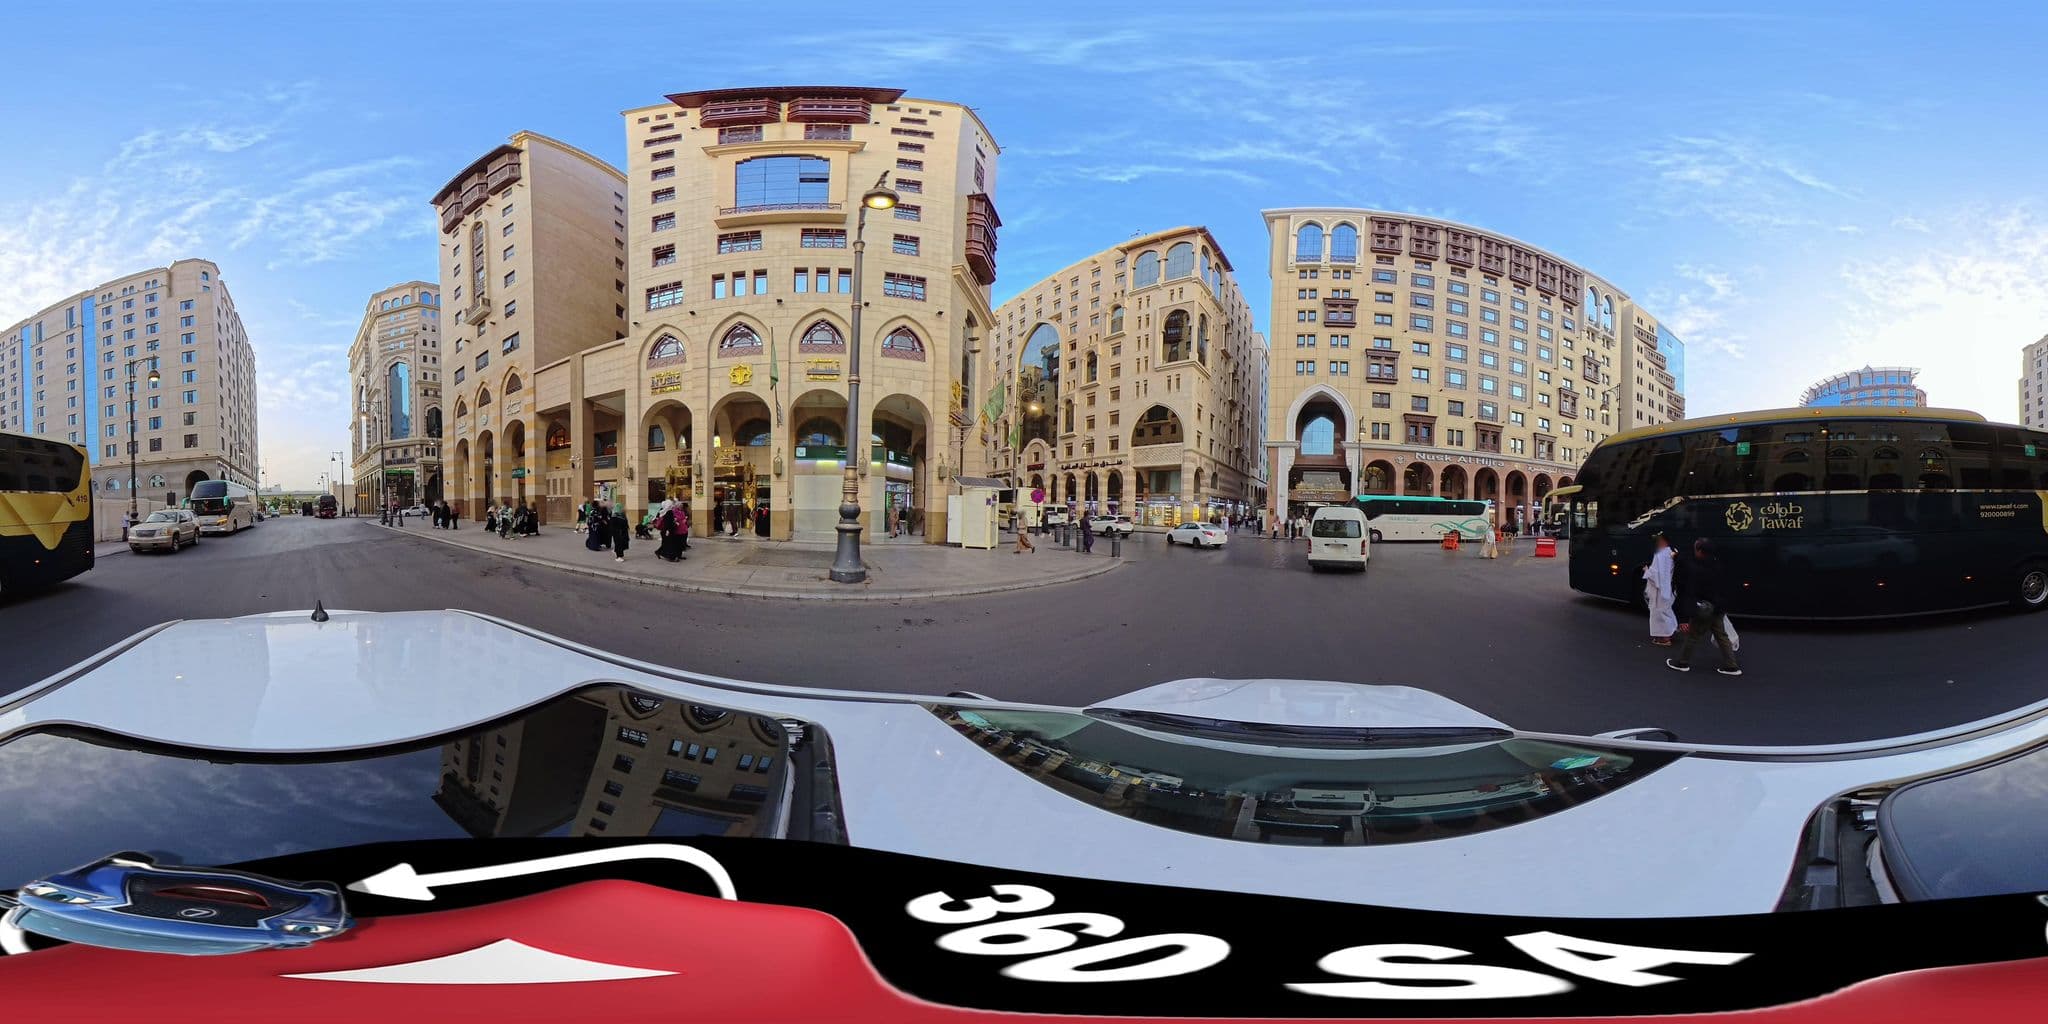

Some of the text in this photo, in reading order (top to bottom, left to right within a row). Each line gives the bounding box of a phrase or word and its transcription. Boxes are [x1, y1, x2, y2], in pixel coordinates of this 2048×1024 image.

[1415, 452, 1452, 463] Nusk
[1760, 502, 1802, 518] طواف
[1759, 516, 1804, 529] Tawaf
